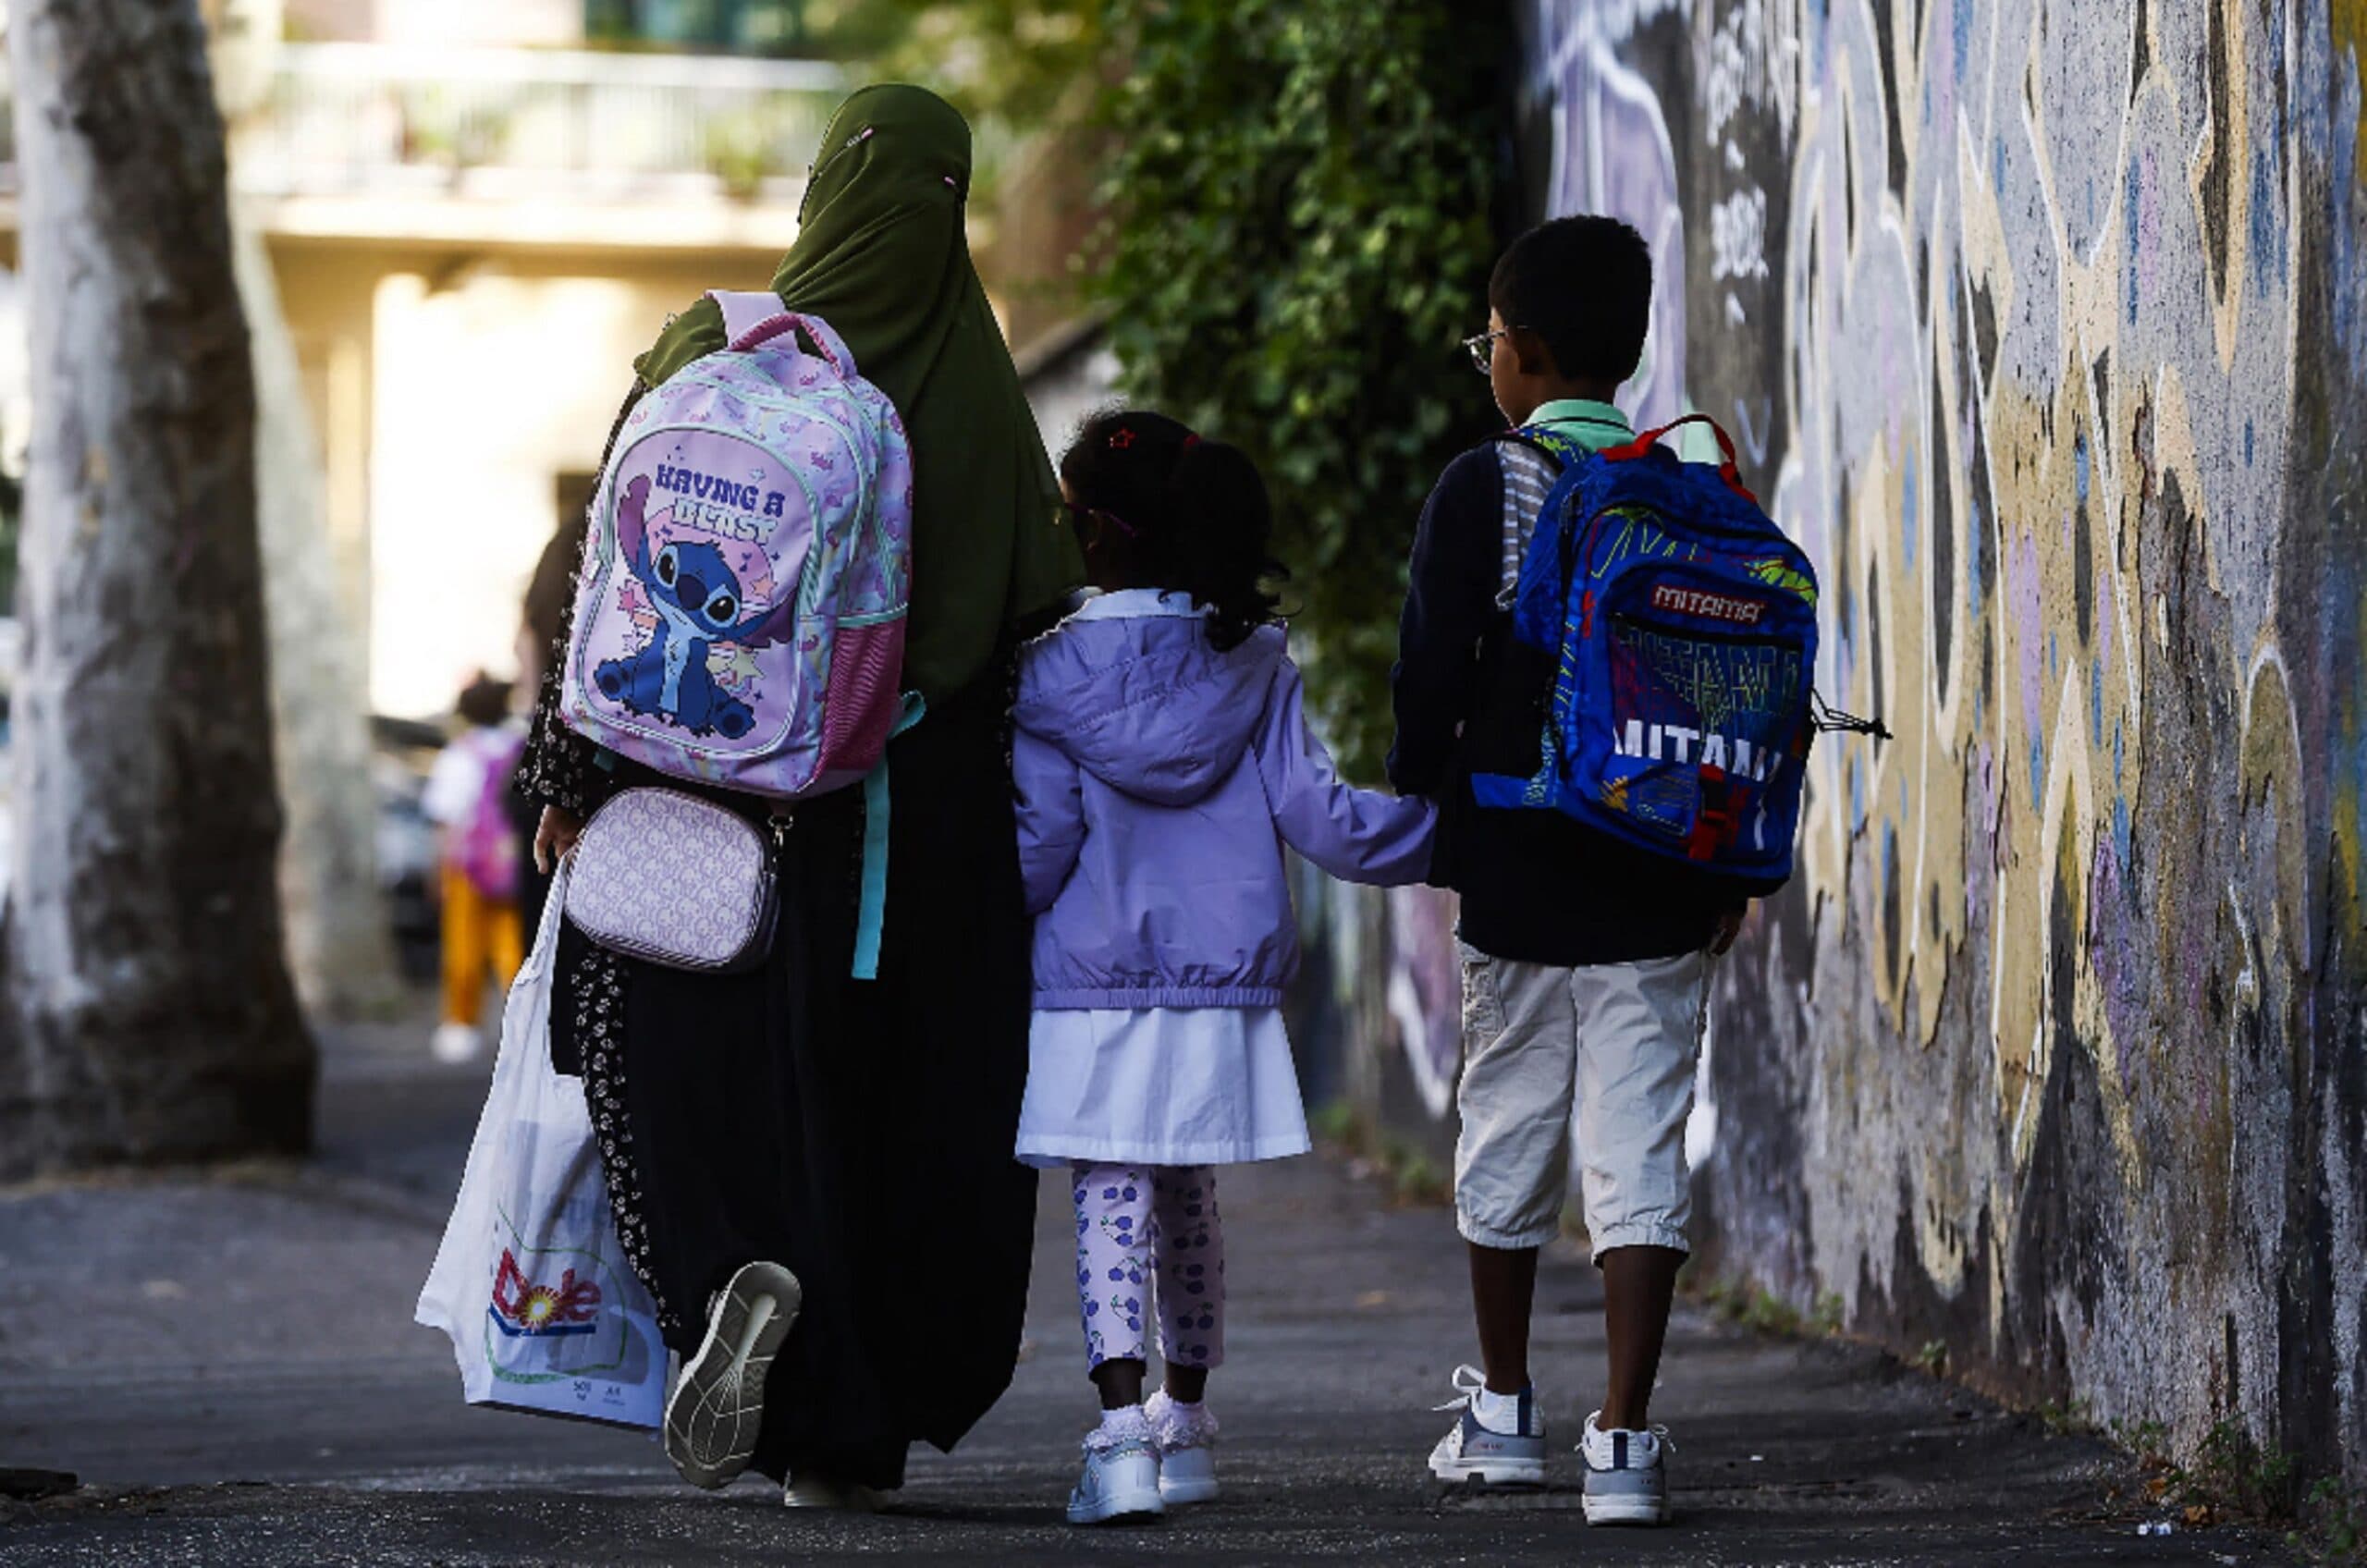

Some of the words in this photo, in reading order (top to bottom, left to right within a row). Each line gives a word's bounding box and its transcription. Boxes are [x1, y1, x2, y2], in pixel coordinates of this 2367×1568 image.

[656, 463, 759, 512] HAVING
[763, 491, 785, 518] A
[1654, 585, 1760, 624] MITAMA
[492, 1246, 601, 1328] Dole
